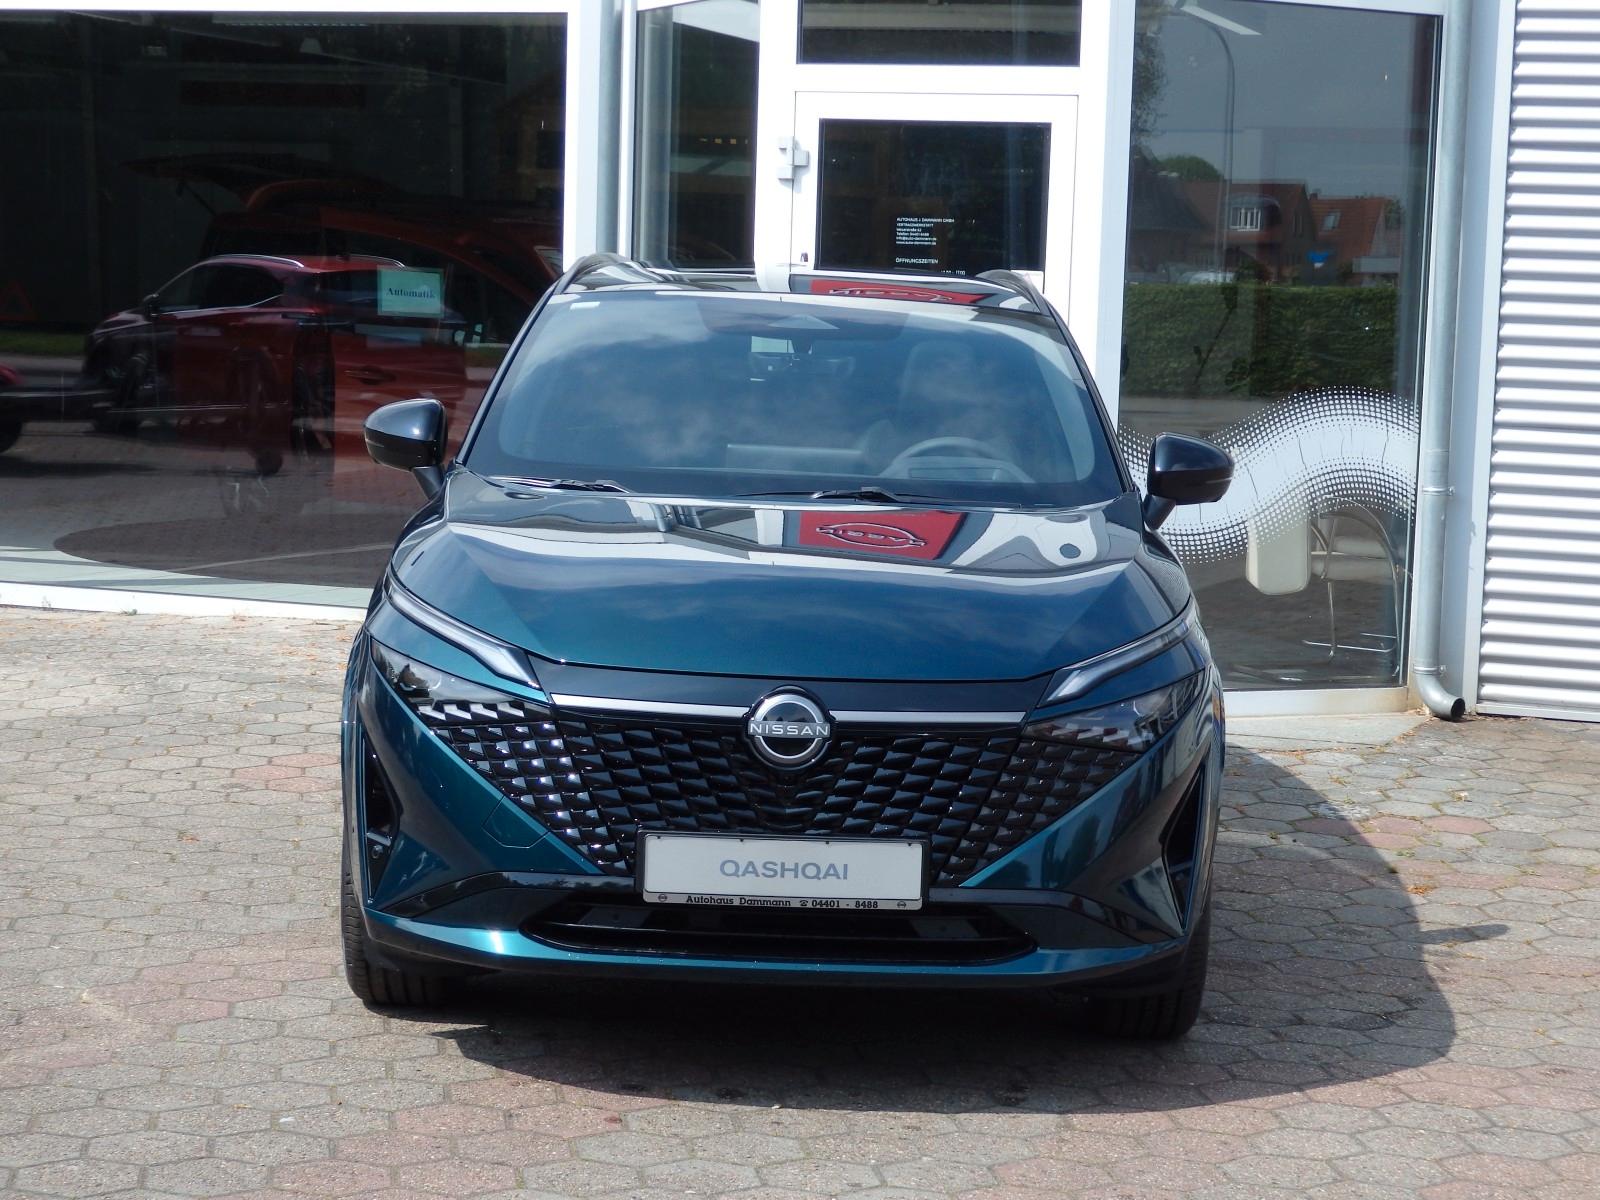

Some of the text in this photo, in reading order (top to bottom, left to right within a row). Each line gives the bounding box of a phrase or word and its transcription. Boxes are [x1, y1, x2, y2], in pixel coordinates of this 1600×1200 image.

[386, 287, 436, 299] Automatik
[749, 722, 829, 736] NISSAN
[719, 859, 849, 881] QASHQAI
[686, 895, 734, 905] Autohaus
[739, 897, 791, 907] Dammann
[811, 900, 840, 908] 04401
[854, 900, 879, 909] 8488
